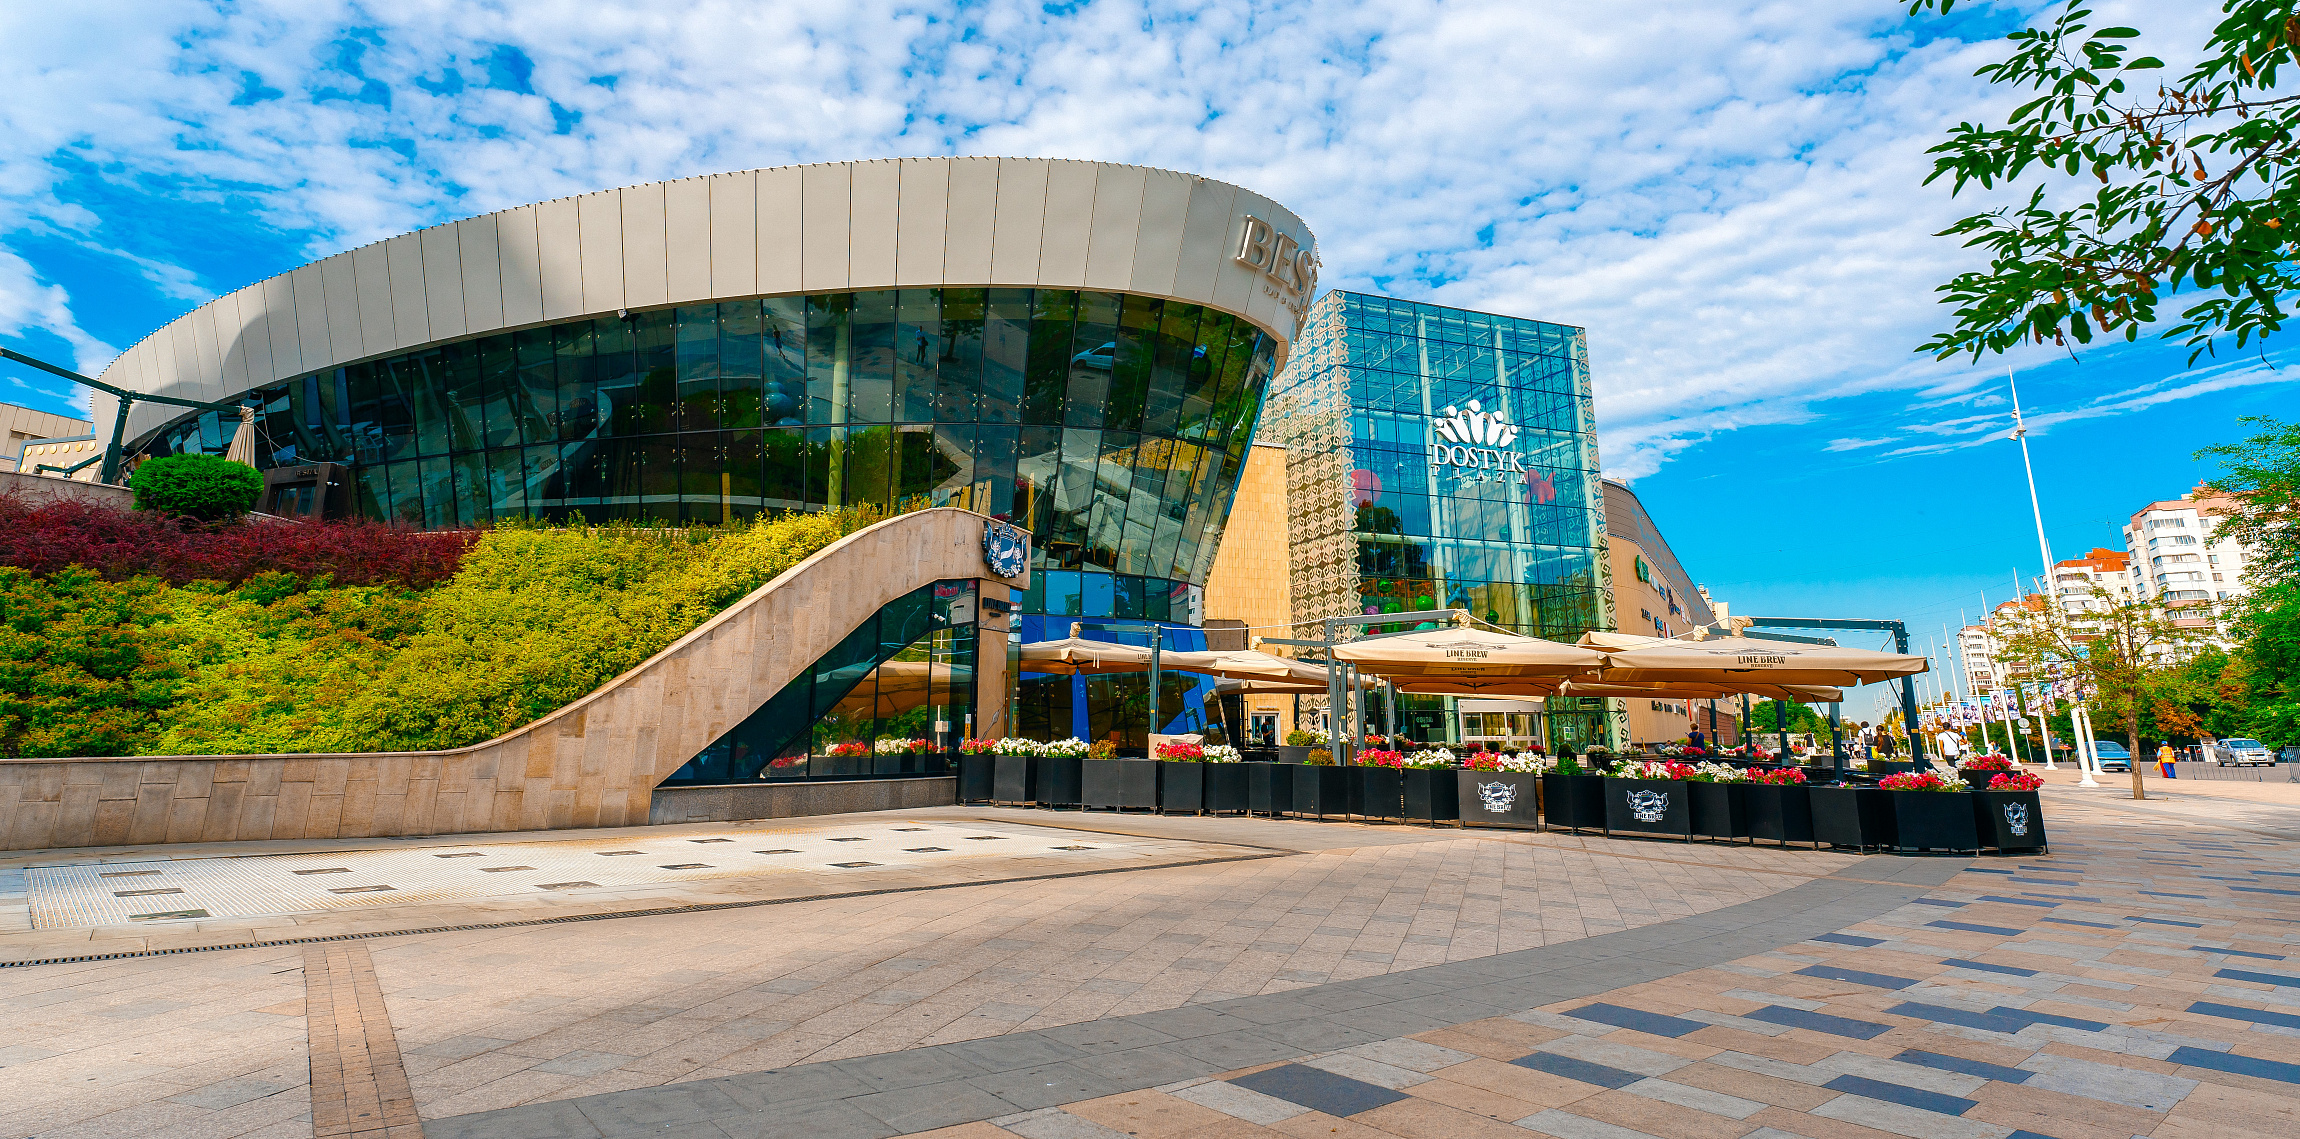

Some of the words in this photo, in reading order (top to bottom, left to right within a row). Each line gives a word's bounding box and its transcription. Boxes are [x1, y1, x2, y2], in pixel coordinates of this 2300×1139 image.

[1431, 444, 1527, 473] DOSTYK
[1432, 466, 1527, 484] PLAZA
[1446, 650, 1464, 658] LINE
[1466, 650, 1488, 658] BREW
[1737, 655, 1758, 664] LINE
[1760, 655, 1785, 664] BREW
